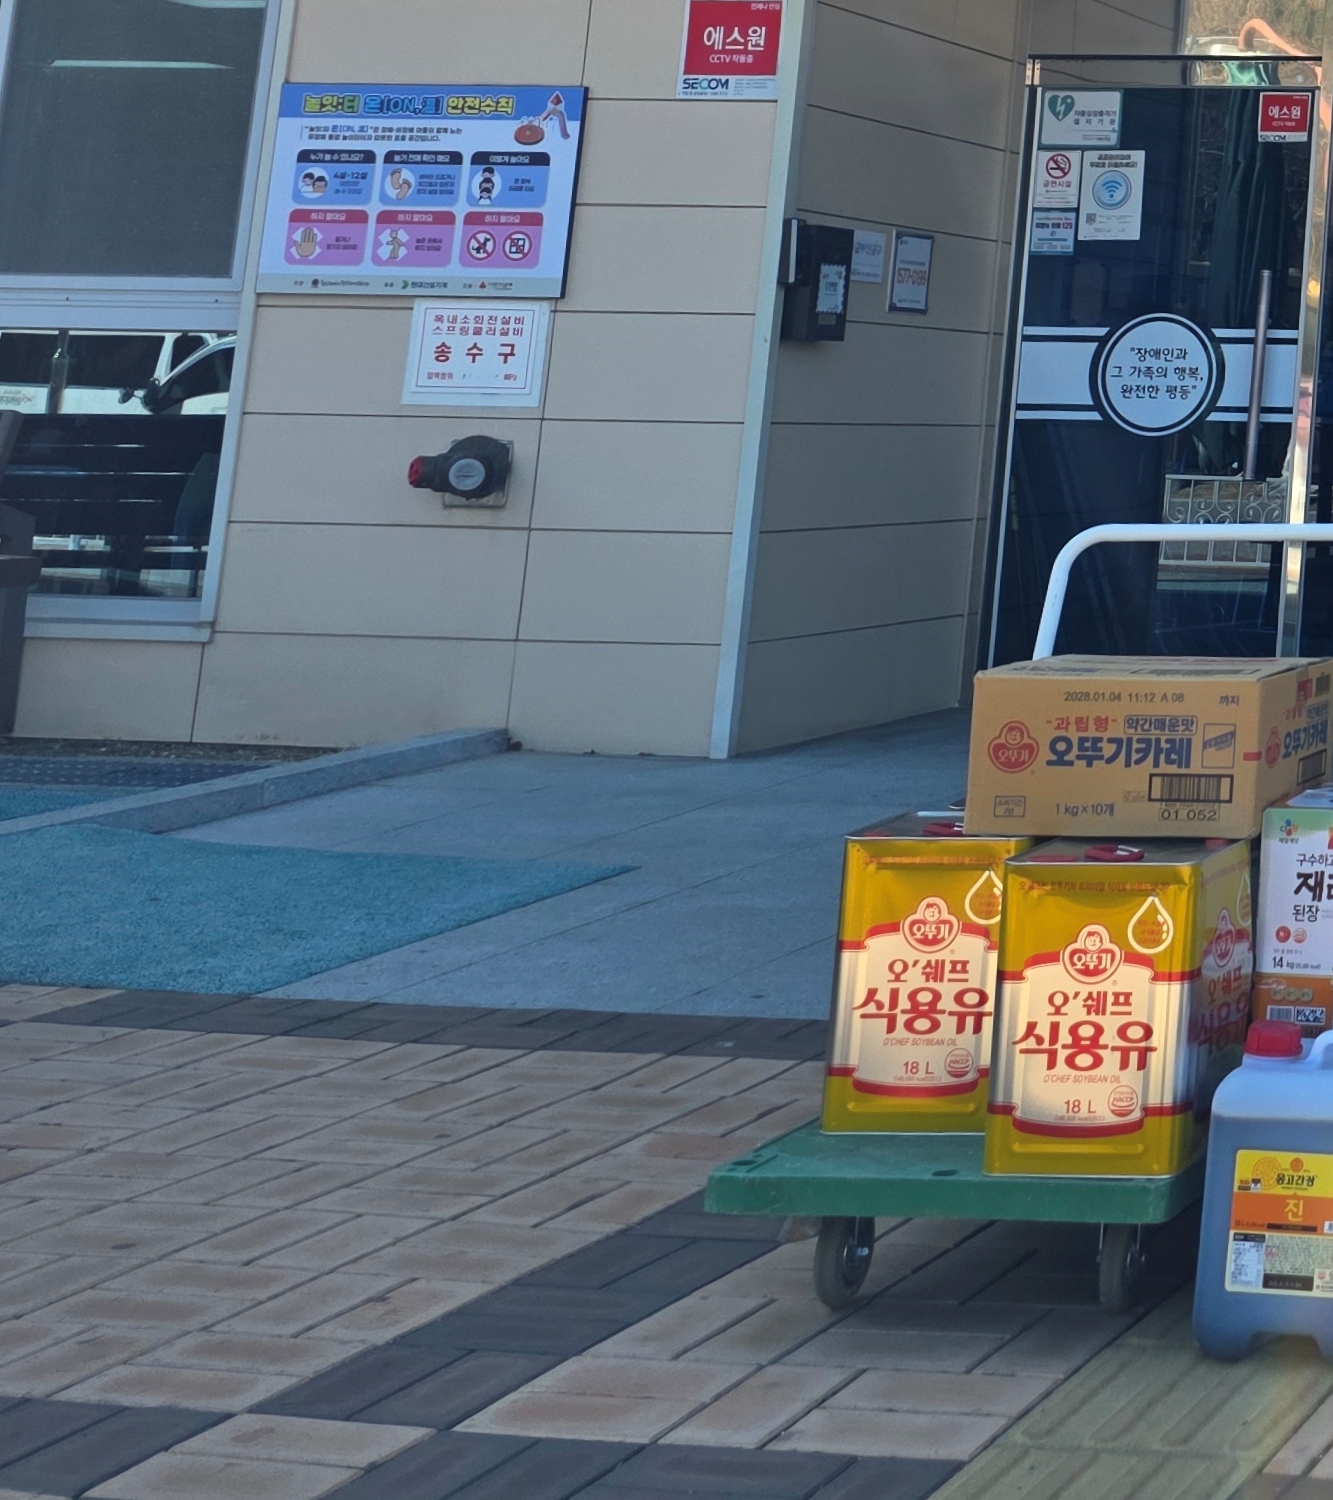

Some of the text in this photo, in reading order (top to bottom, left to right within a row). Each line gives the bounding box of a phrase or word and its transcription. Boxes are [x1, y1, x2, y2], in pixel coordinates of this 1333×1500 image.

[703, 26, 766, 50] 에스원
[709, 54, 753, 63] CCTV 작동중
[682, 78, 729, 90] SECOM
[446, 96, 516, 115] 안전수칙
[1268, 105, 1301, 120] 에스원
[1043, 180, 1072, 188] 금연시설
[1111, 365, 1204, 382] 그 가족의 행복,
[1120, 384, 1160, 400] 완전한
[1127, 692, 1155, 703] 11:12
[1219, 695, 1239, 707] 까지
[1126, 717, 1194, 733] 약간매운맛
[1046, 736, 1192, 768] 오뚜기카레
[1160, 809, 1217, 820] 01 052
[1292, 904, 1320, 922] 된장
[1272, 956, 1284, 968] 14
[887, 959, 970, 983] 오'쉐프
[852, 986, 993, 1035] 식용유
[911, 1037, 945, 1046] SOYBEAN
[946, 1037, 958, 1046] OIL
[1011, 1020, 1158, 1072] 식용유
[903, 1061, 934, 1075] 18 L
[1043, 1074, 1121, 1083] O'CHEF SOYBEAN OIL
[1064, 1099, 1081, 1114] 18
[1276, 1173, 1316, 1187] 몽고간장
[1285, 1199, 1303, 1221] 진
